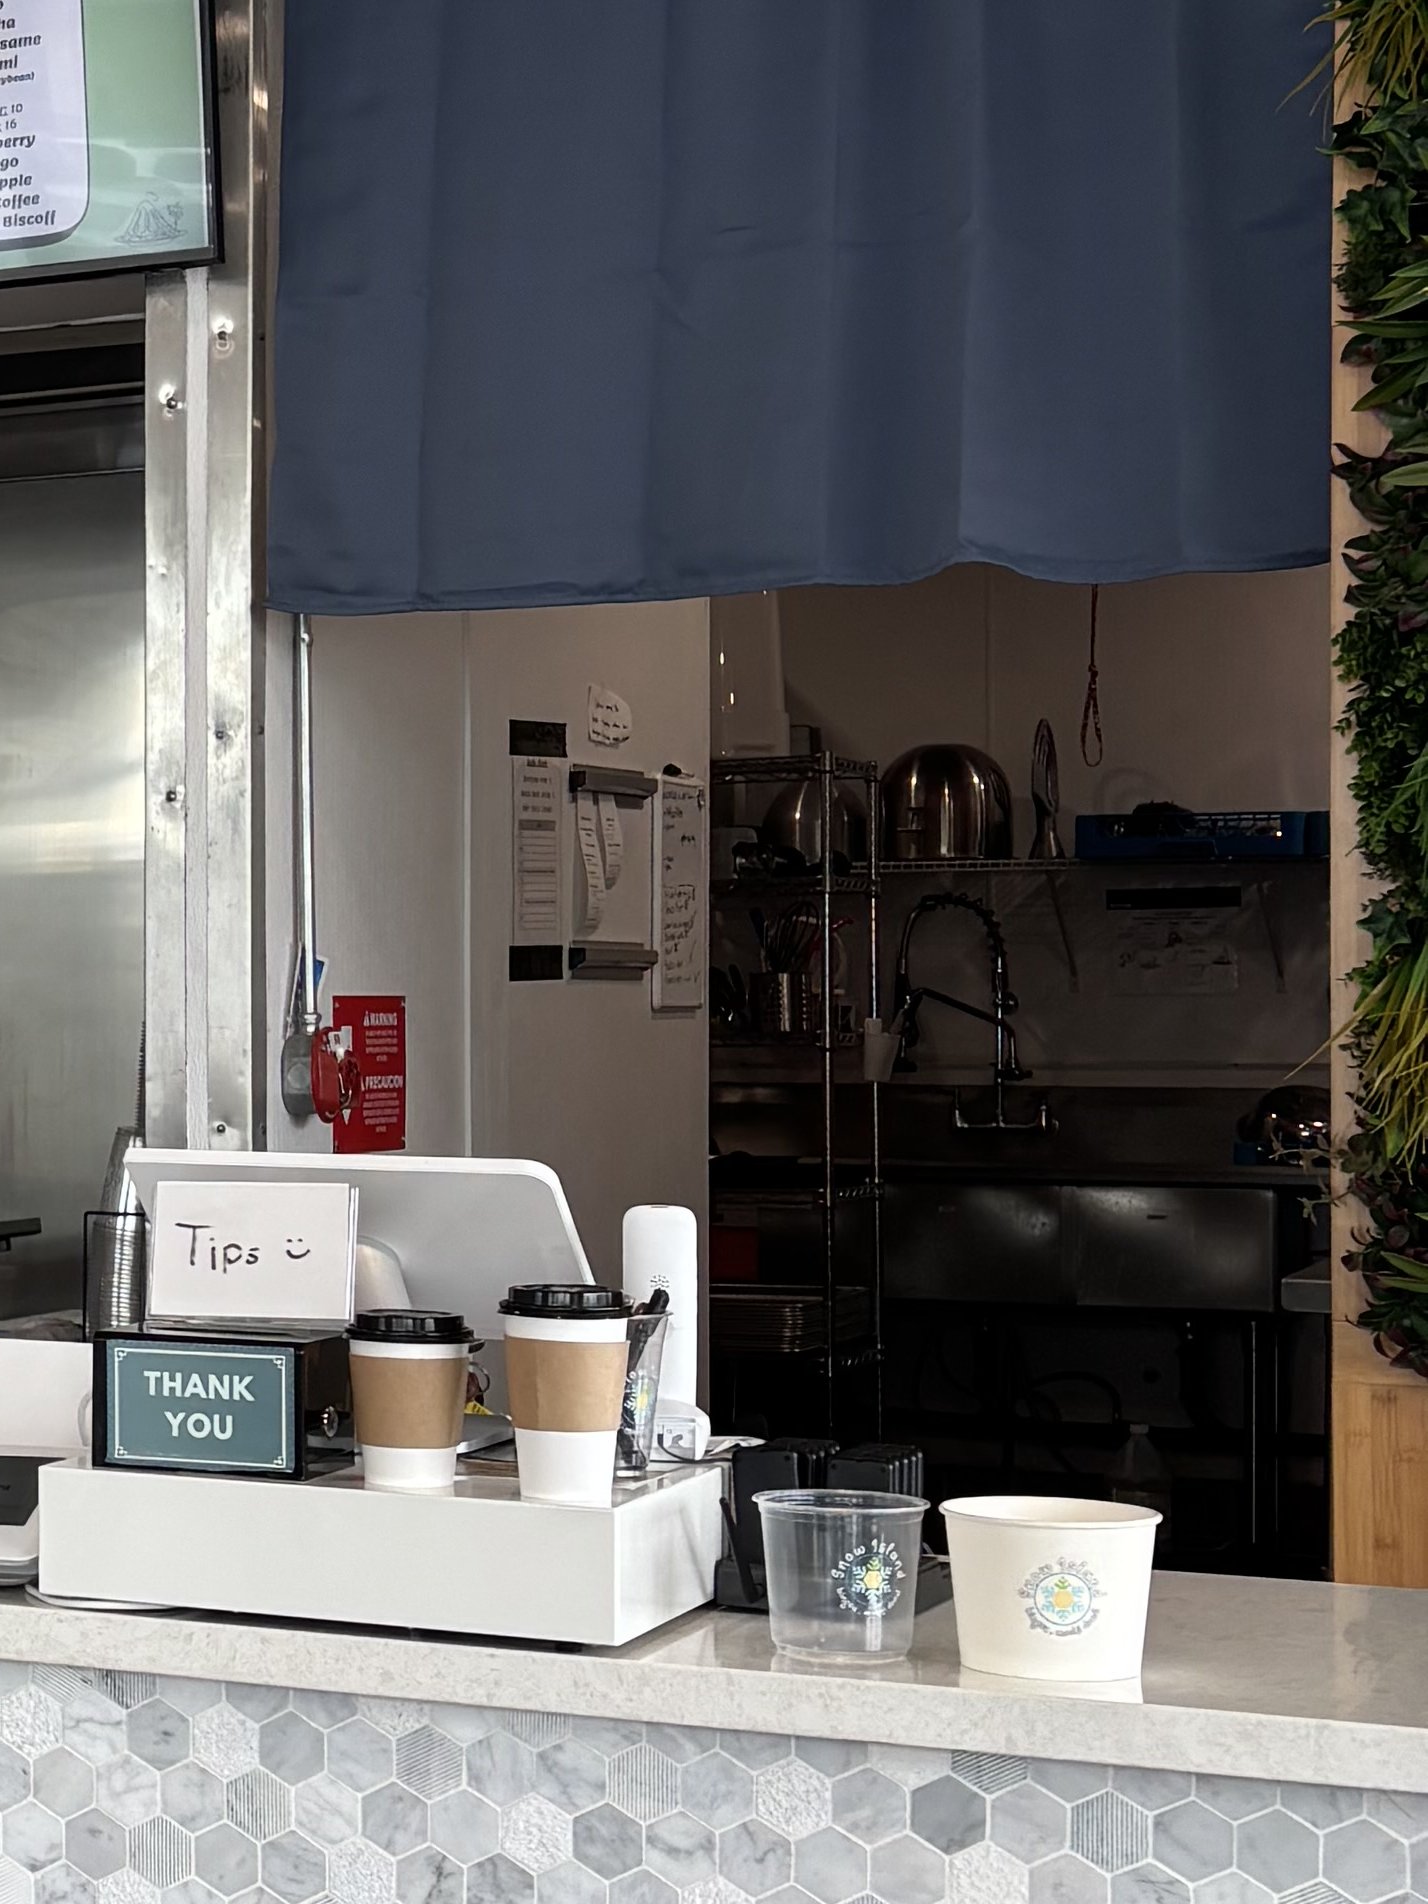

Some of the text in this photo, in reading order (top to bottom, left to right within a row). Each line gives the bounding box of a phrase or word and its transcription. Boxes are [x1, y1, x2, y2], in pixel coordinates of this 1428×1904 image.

[11, 104, 23, 113] 10
[5, 119, 17, 130] 16
[3, 210, 56, 227] Biscoff
[175, 1223, 259, 1274] Tips
[143, 1371, 255, 1401] THANK
[164, 1411, 233, 1440] YOU
[831, 1538, 907, 1579] Snow Island
